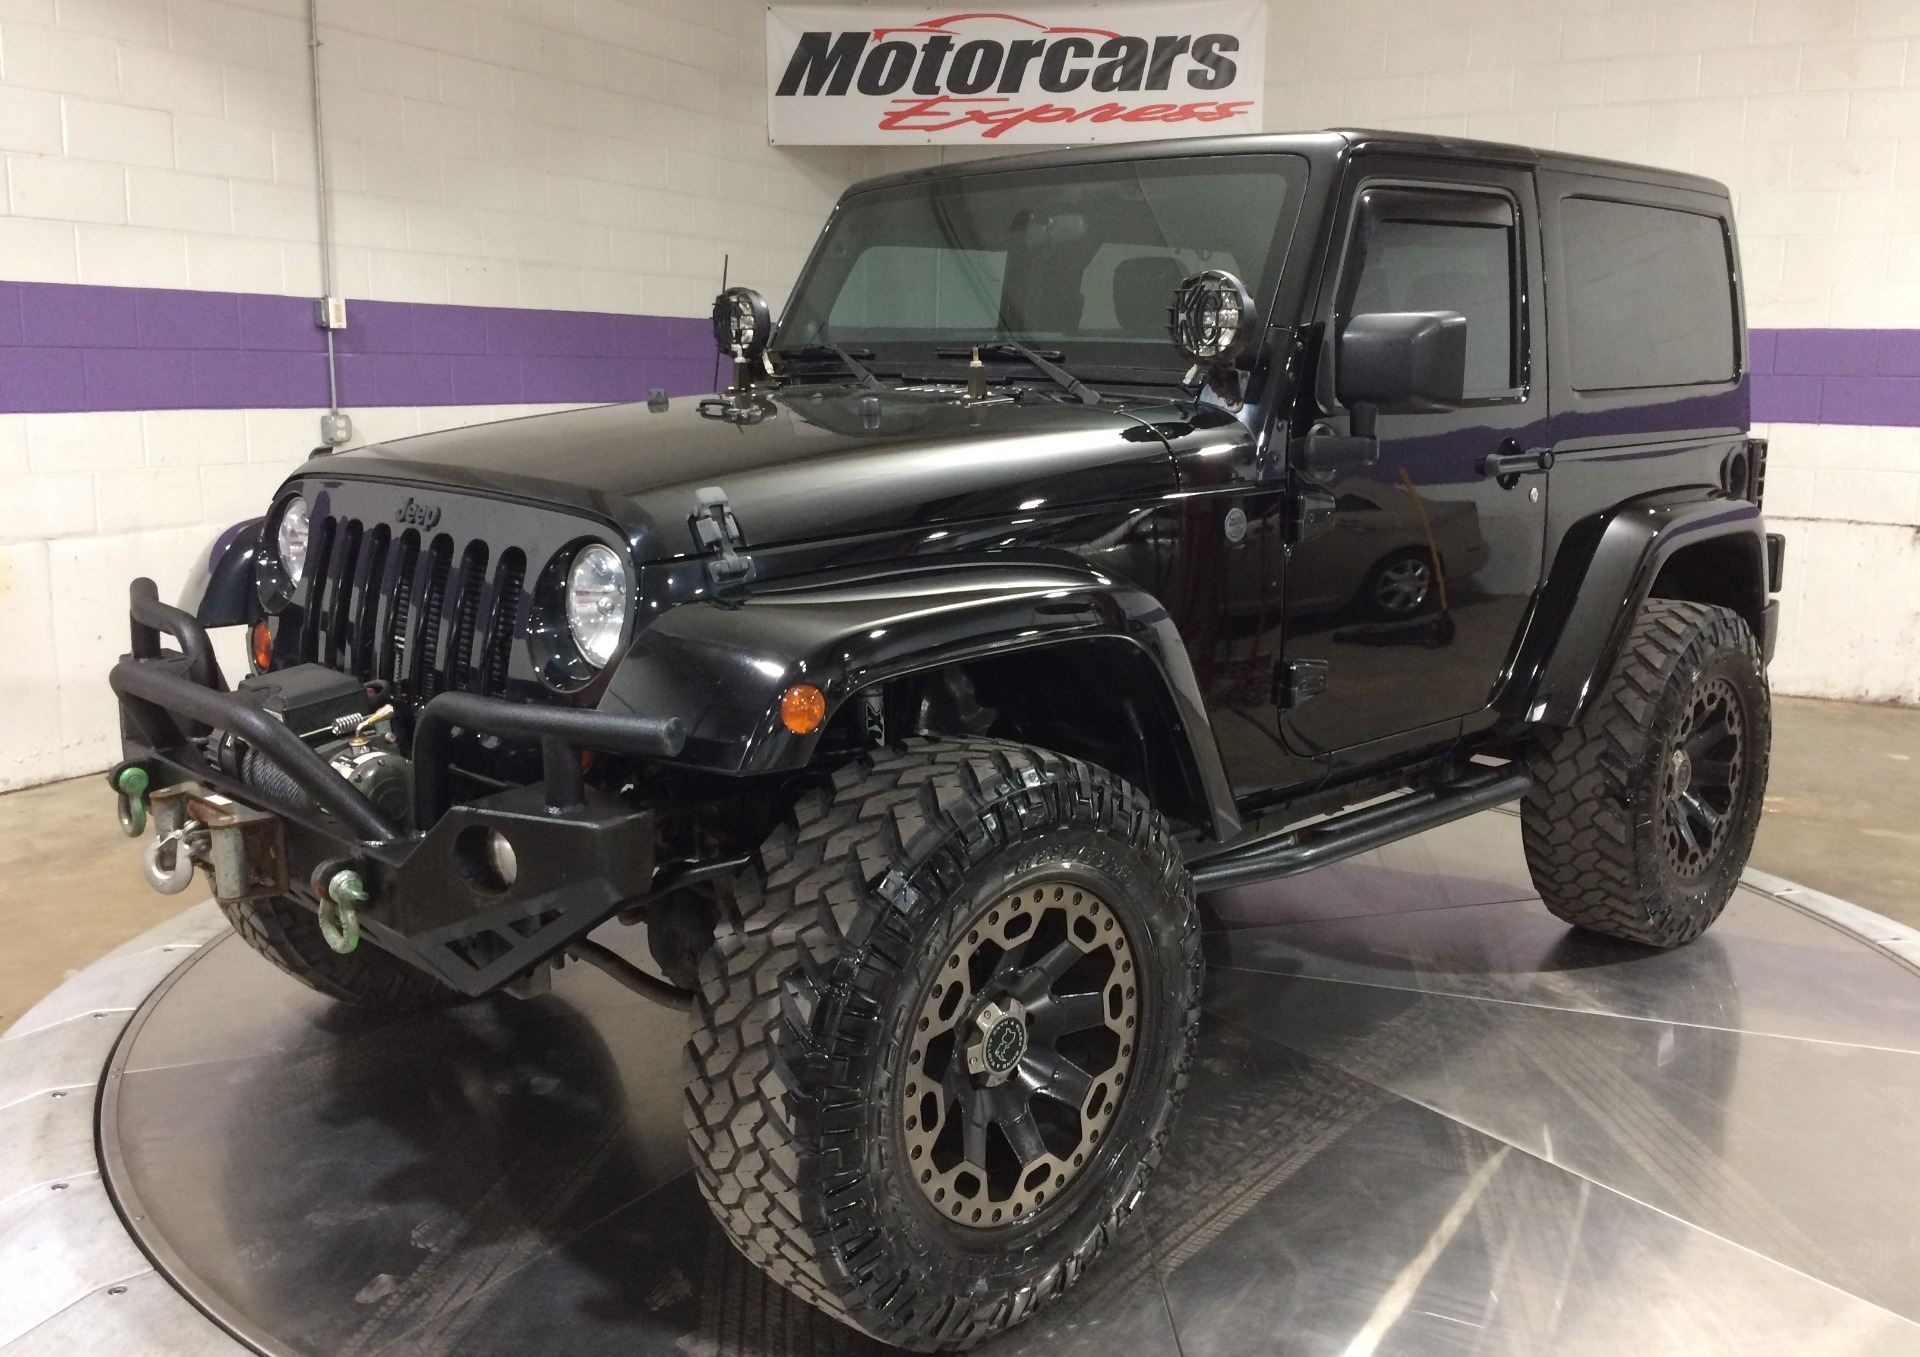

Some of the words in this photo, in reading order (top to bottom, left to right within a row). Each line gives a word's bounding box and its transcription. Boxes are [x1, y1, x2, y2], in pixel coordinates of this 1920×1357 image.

[775, 32, 1239, 96] Motorcars
[878, 96, 1254, 138] Express
[395, 497, 441, 531] Jeep
